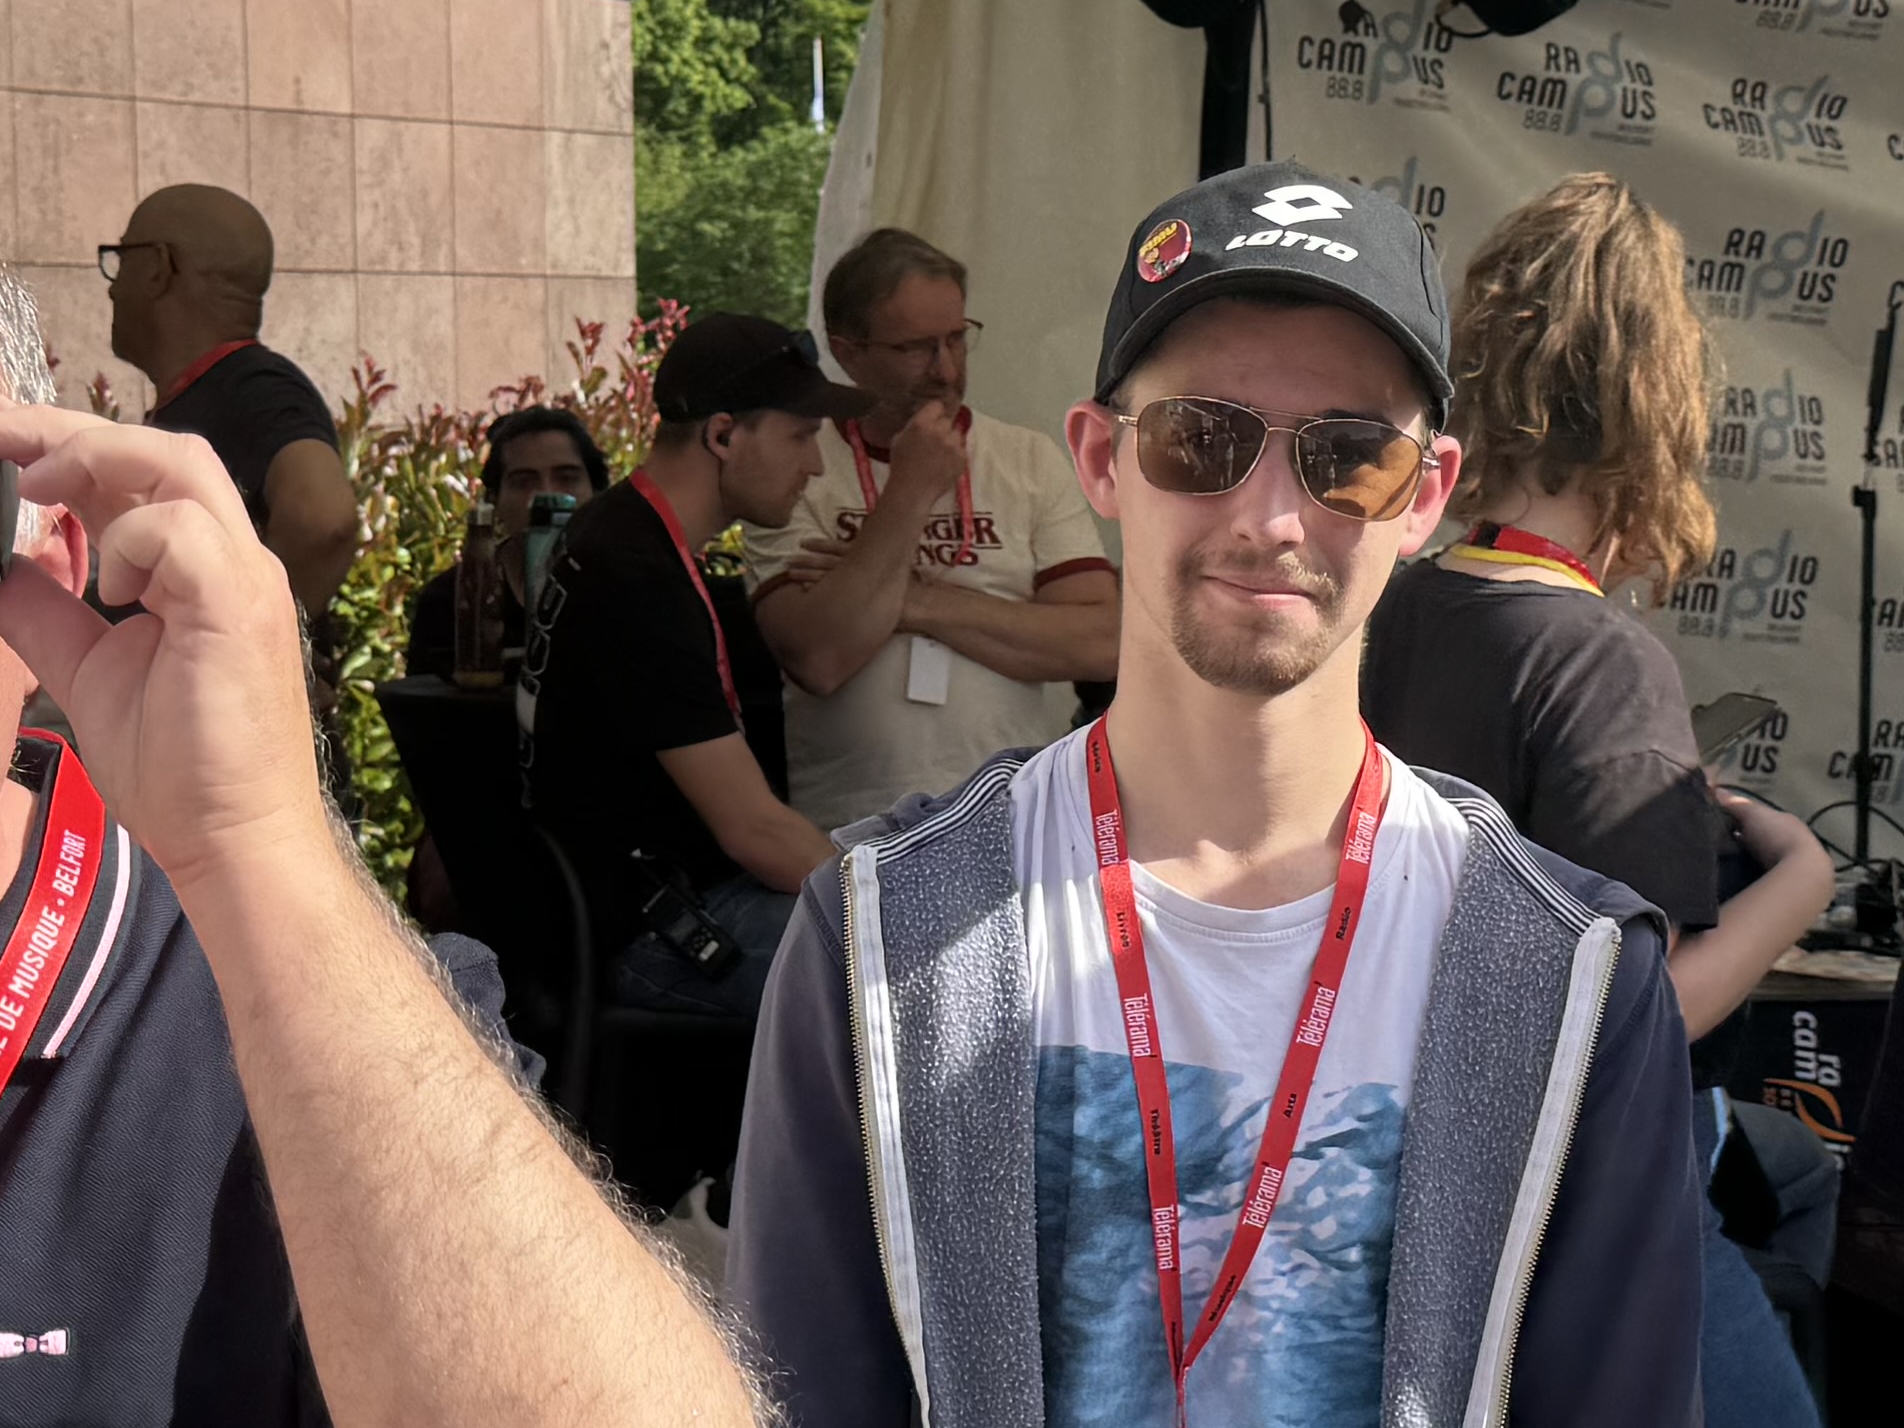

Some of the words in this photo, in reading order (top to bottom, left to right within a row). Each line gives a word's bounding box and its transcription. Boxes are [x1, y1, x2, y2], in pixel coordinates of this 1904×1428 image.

[1225, 229, 1359, 262] LOTTO
[7, 904, 66, 999] MUSIQUE
[52, 828, 88, 899] BELFORT
